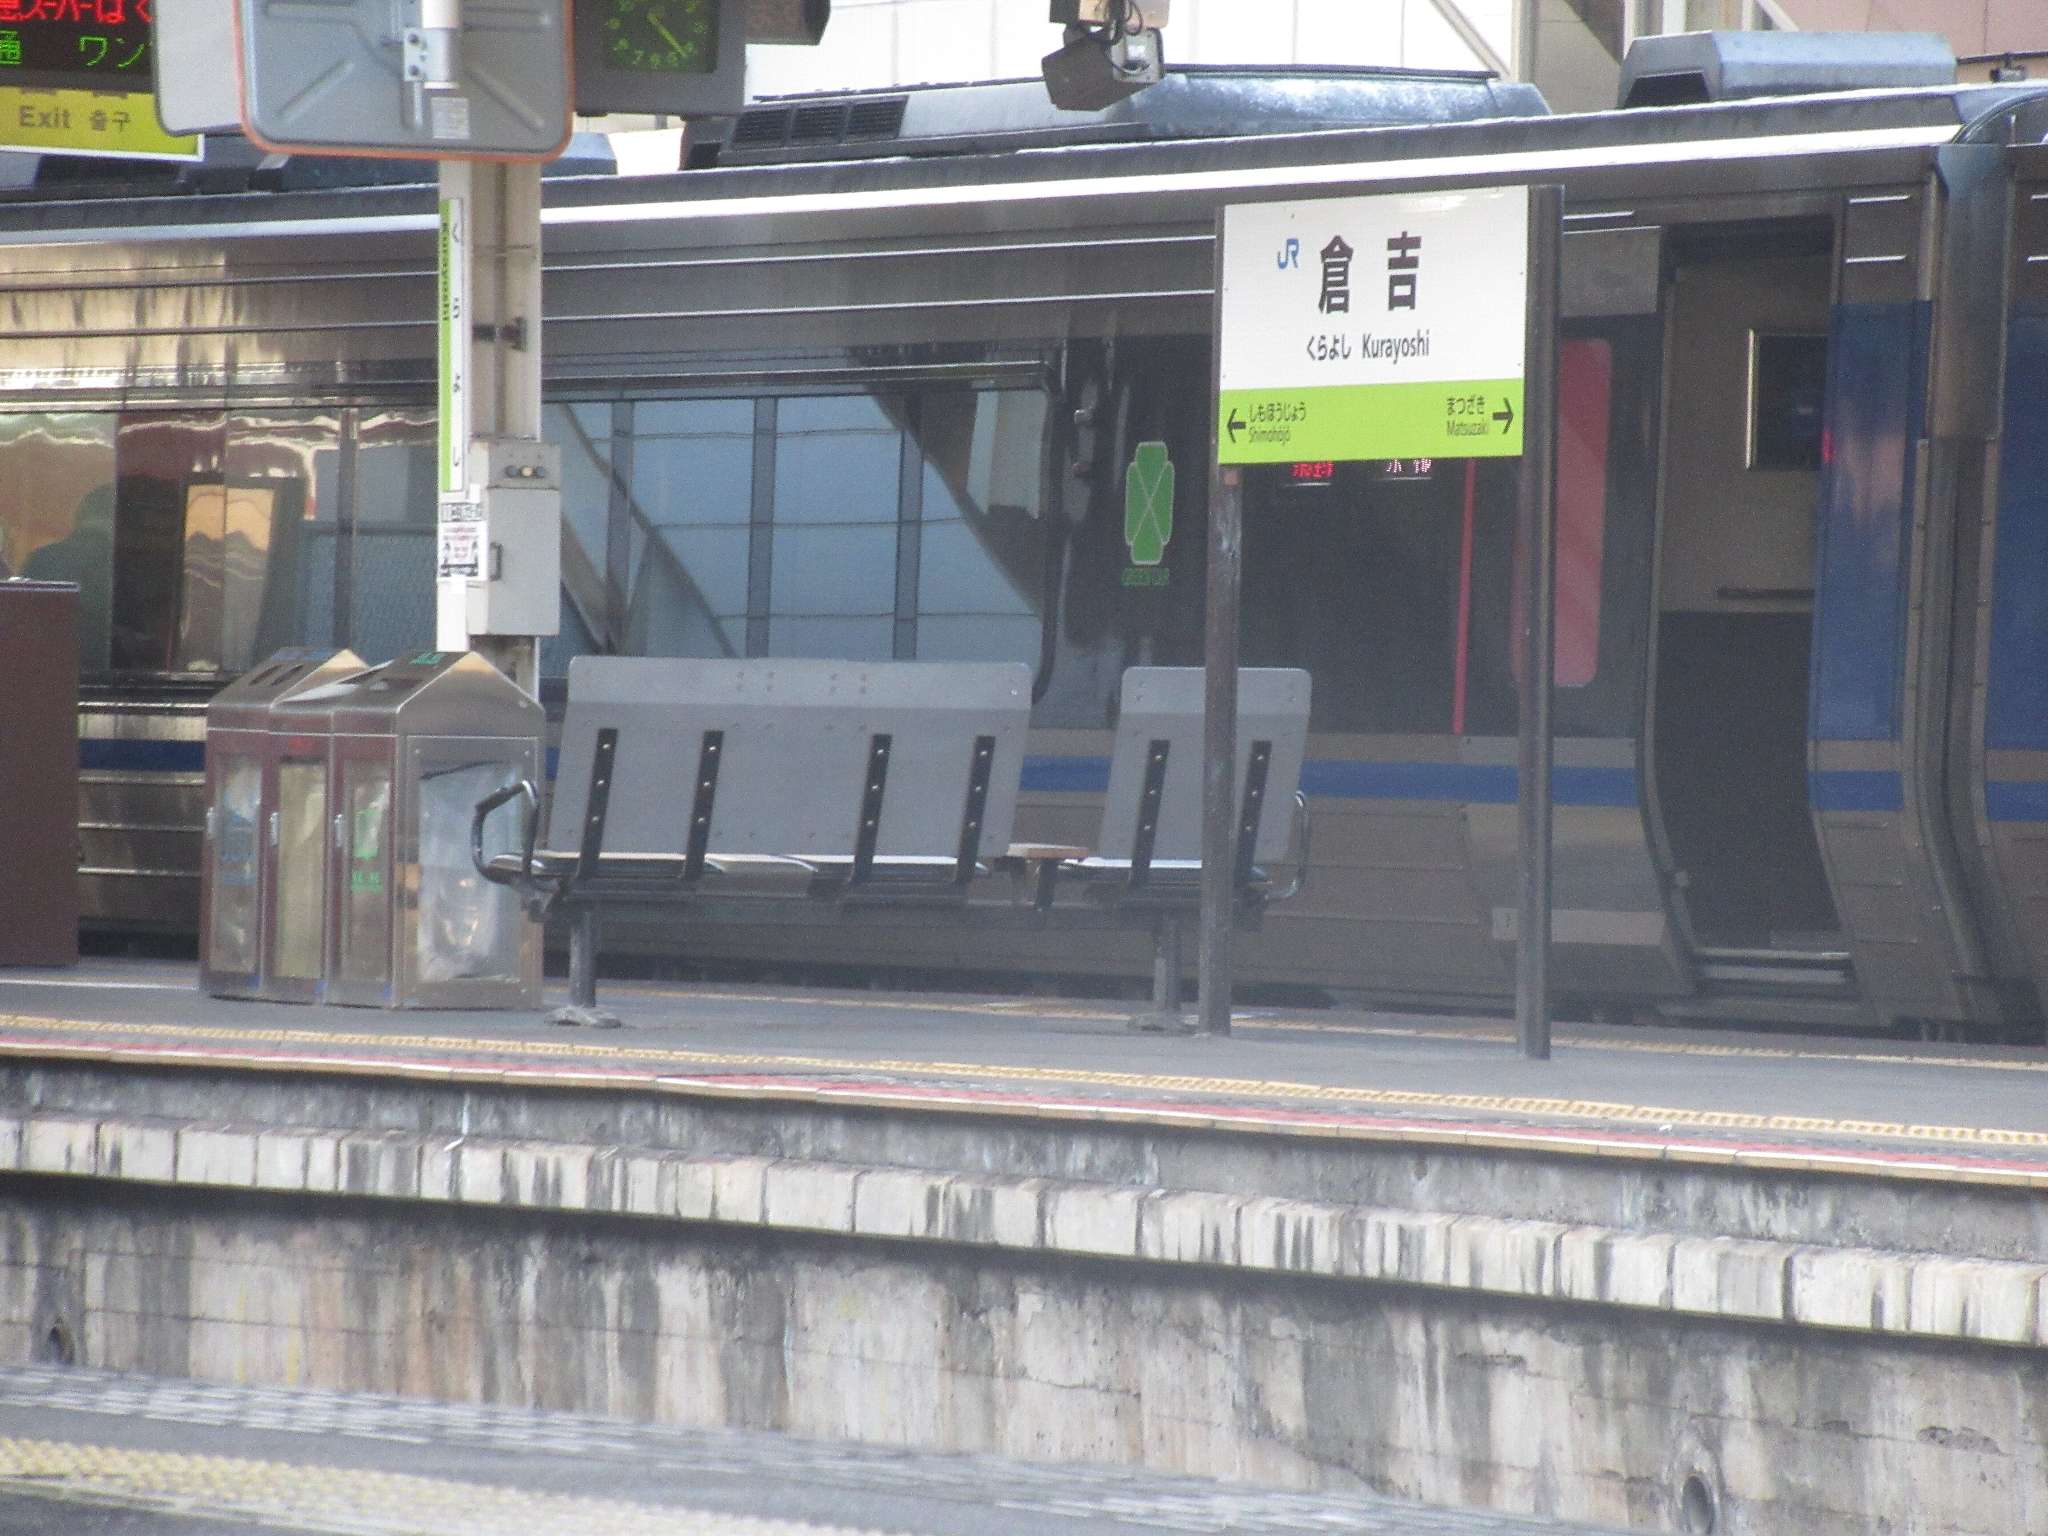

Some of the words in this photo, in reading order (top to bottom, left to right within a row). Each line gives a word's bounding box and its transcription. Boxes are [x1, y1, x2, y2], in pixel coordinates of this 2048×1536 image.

[20, 105, 71, 129] Exit
[1277, 237, 1300, 270] JR
[1318, 230, 1423, 315] 倉吉
[1306, 333, 1352, 361] くらよし
[1362, 328, 1431, 365] Kurayoshi
